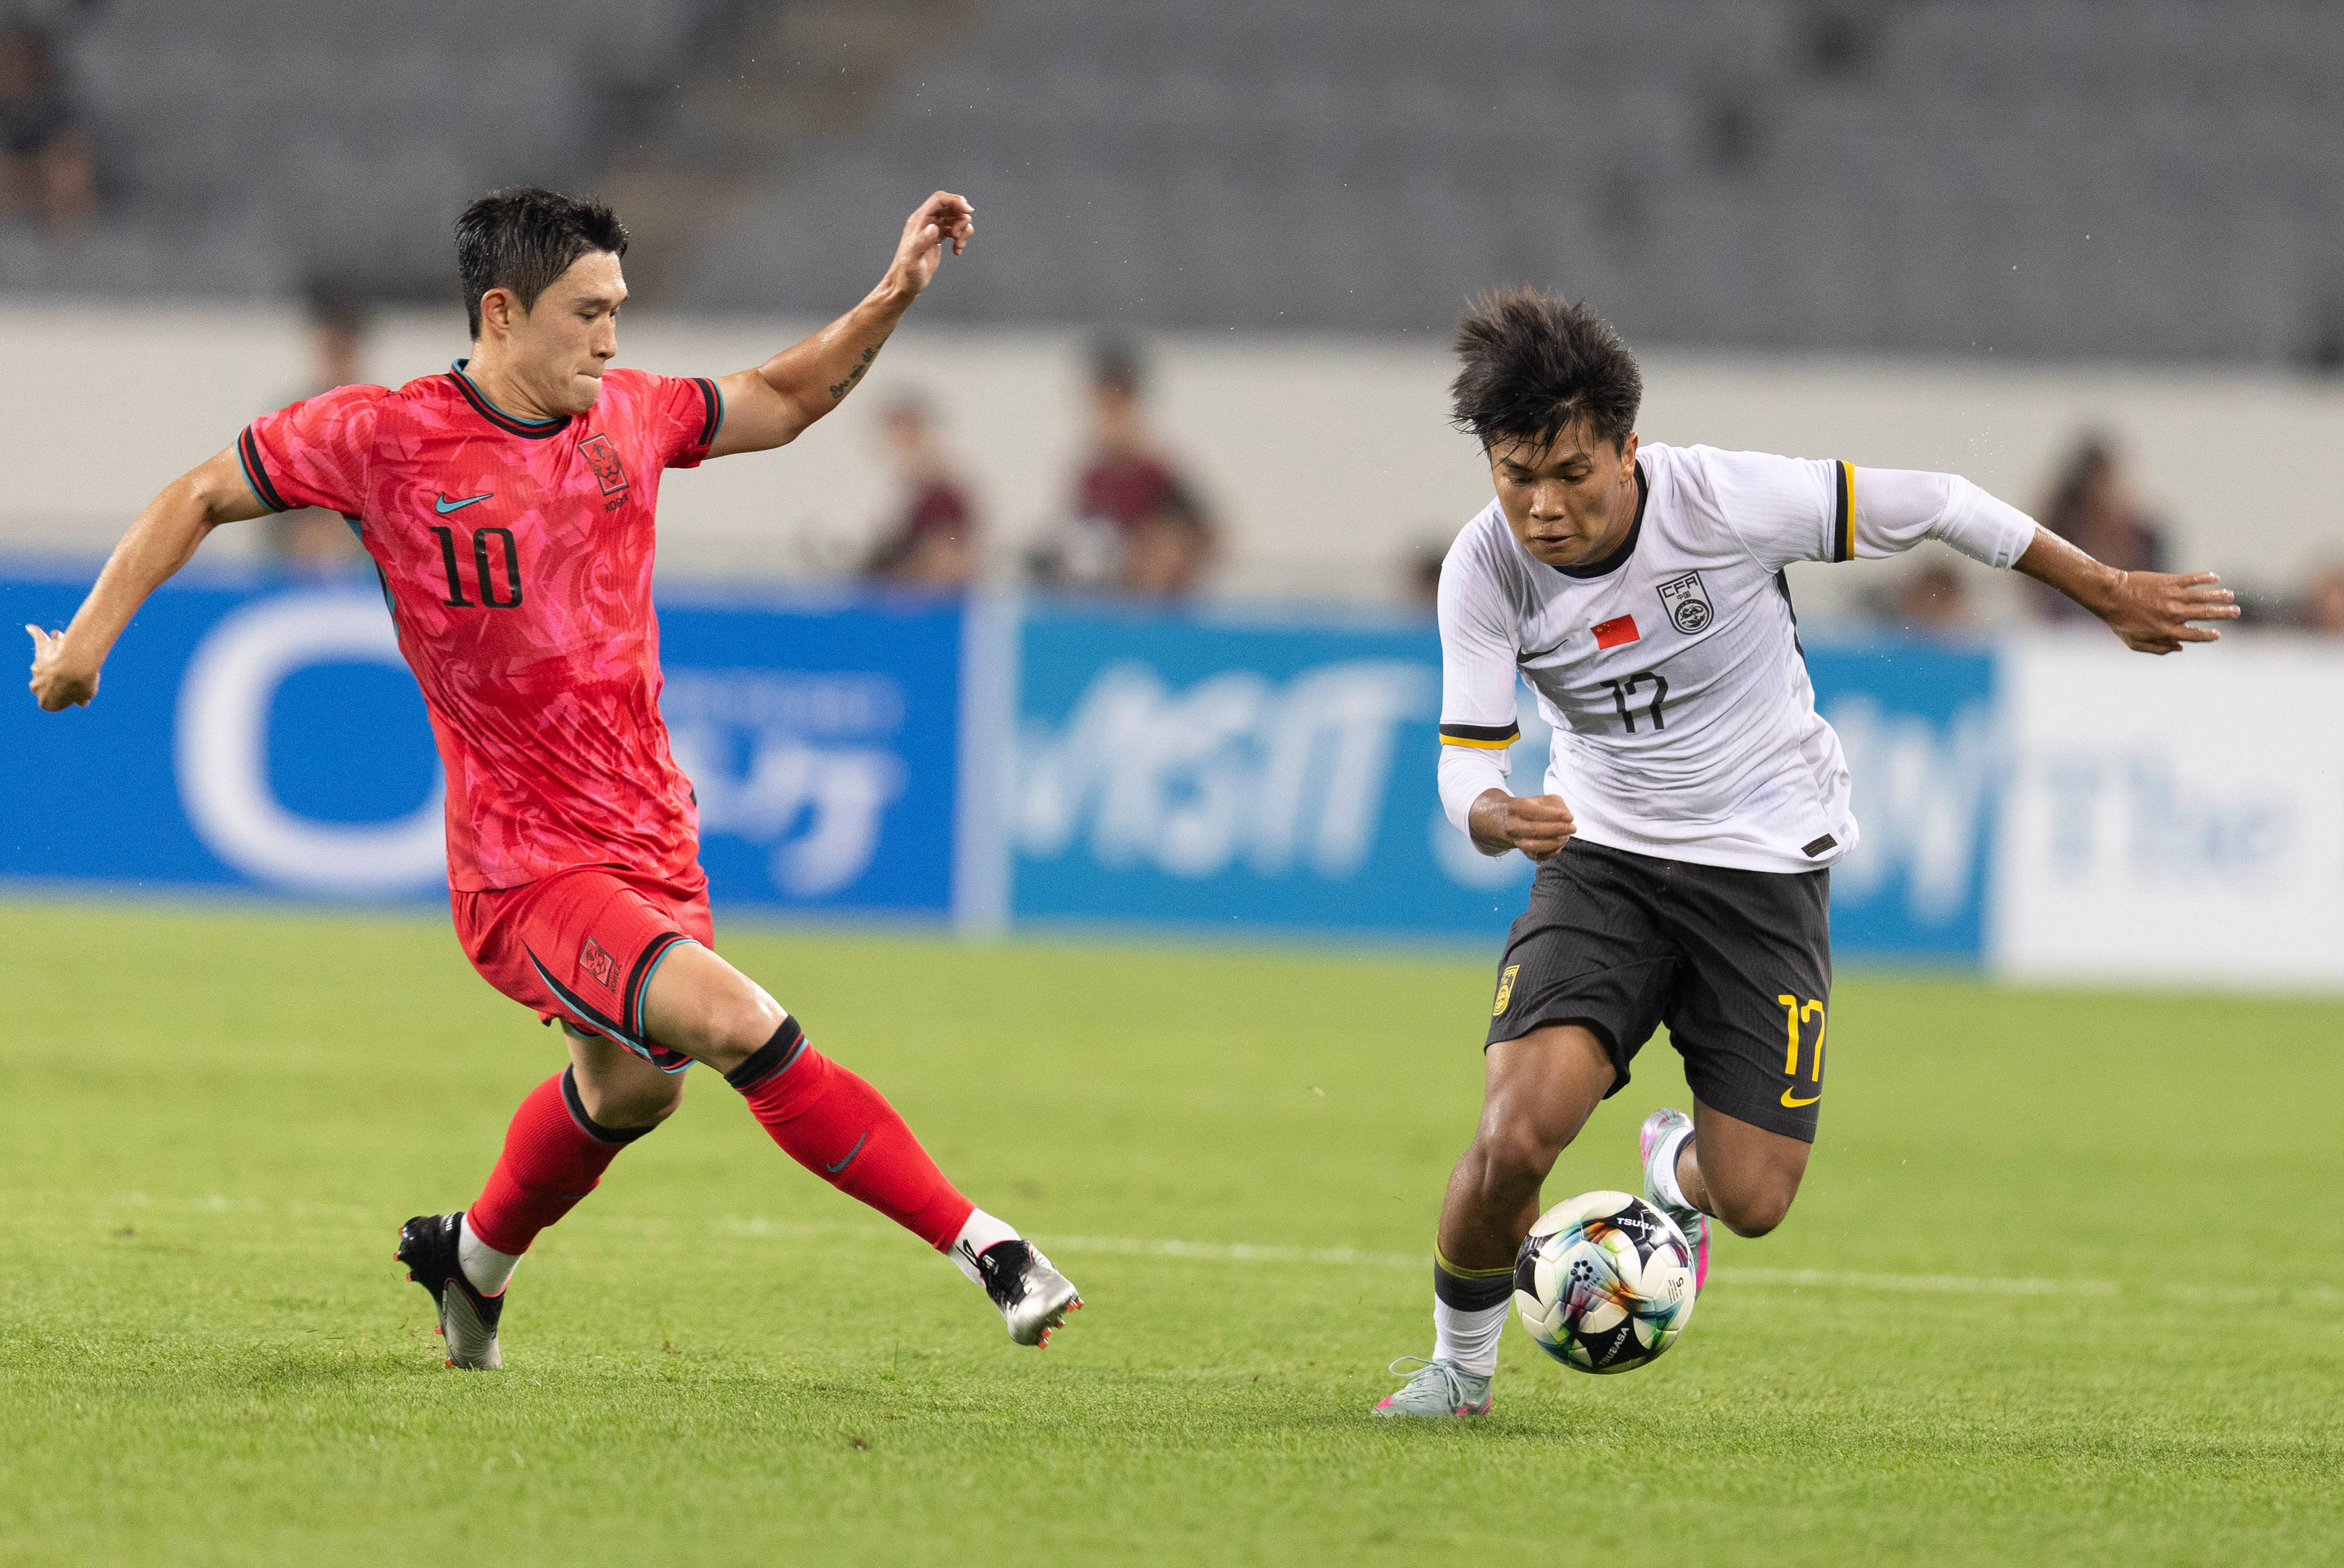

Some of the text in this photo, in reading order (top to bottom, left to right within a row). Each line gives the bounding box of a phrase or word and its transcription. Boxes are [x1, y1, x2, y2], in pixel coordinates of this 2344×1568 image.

[428, 526, 523, 608] 10
[1662, 576, 1698, 598] CFA
[1600, 672, 1668, 732] 17
[1778, 994, 1825, 1082] 17
[1616, 1218, 1663, 1233] TSUBA
